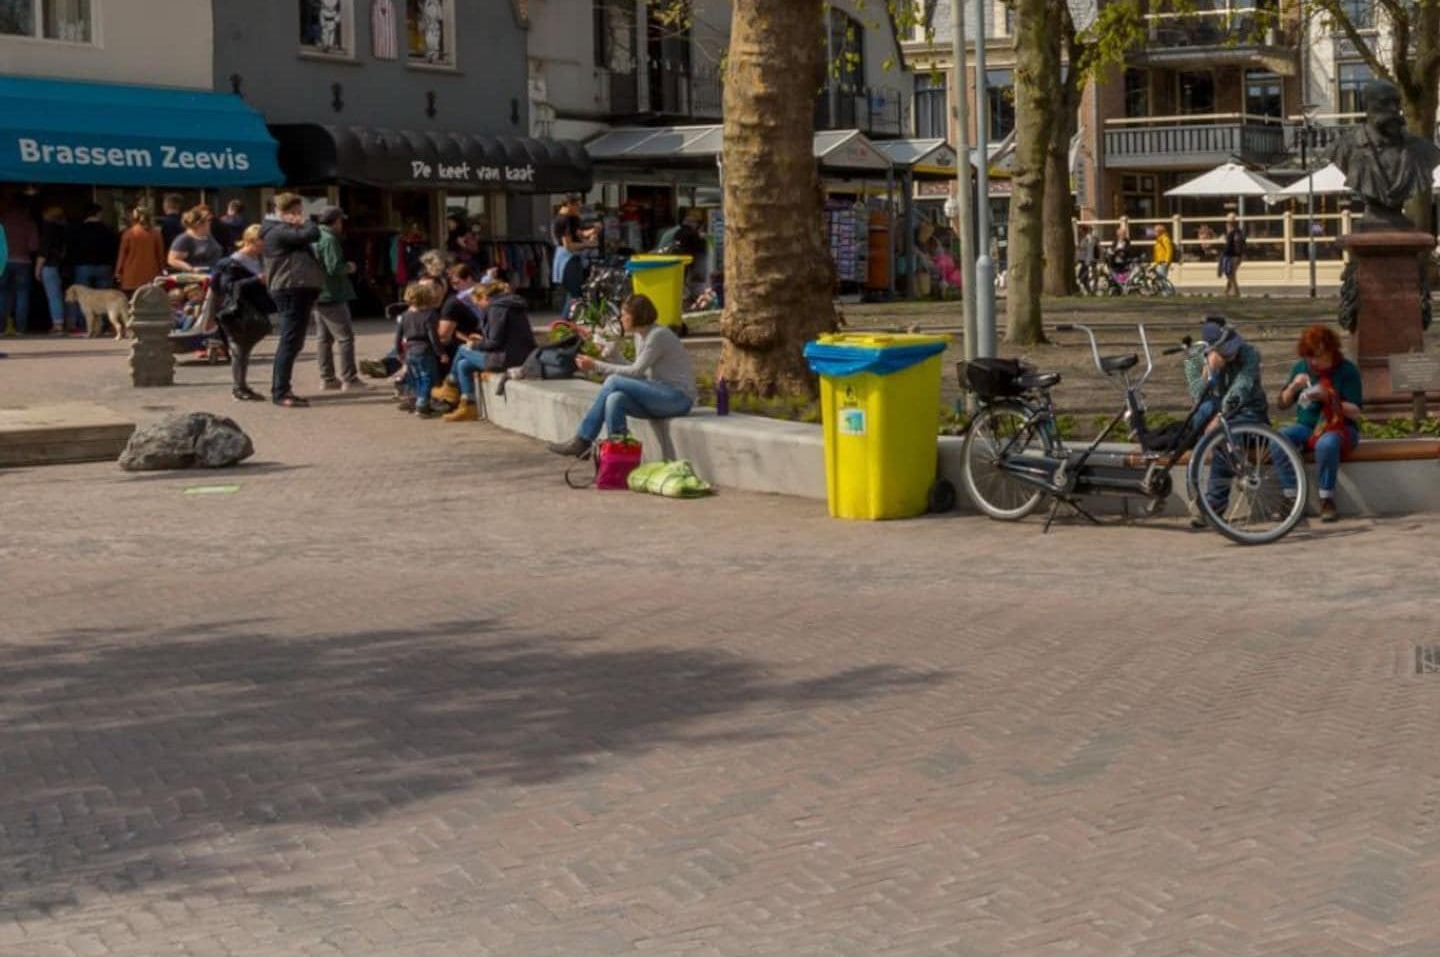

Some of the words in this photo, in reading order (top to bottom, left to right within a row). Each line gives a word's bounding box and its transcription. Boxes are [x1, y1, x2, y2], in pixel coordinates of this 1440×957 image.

[18, 138, 152, 167] Brassem
[160, 145, 250, 171] Zeevis
[411, 160, 432, 179] De
[438, 161, 471, 180] keet
[476, 165, 500, 181] van
[504, 163, 536, 182] kaat
